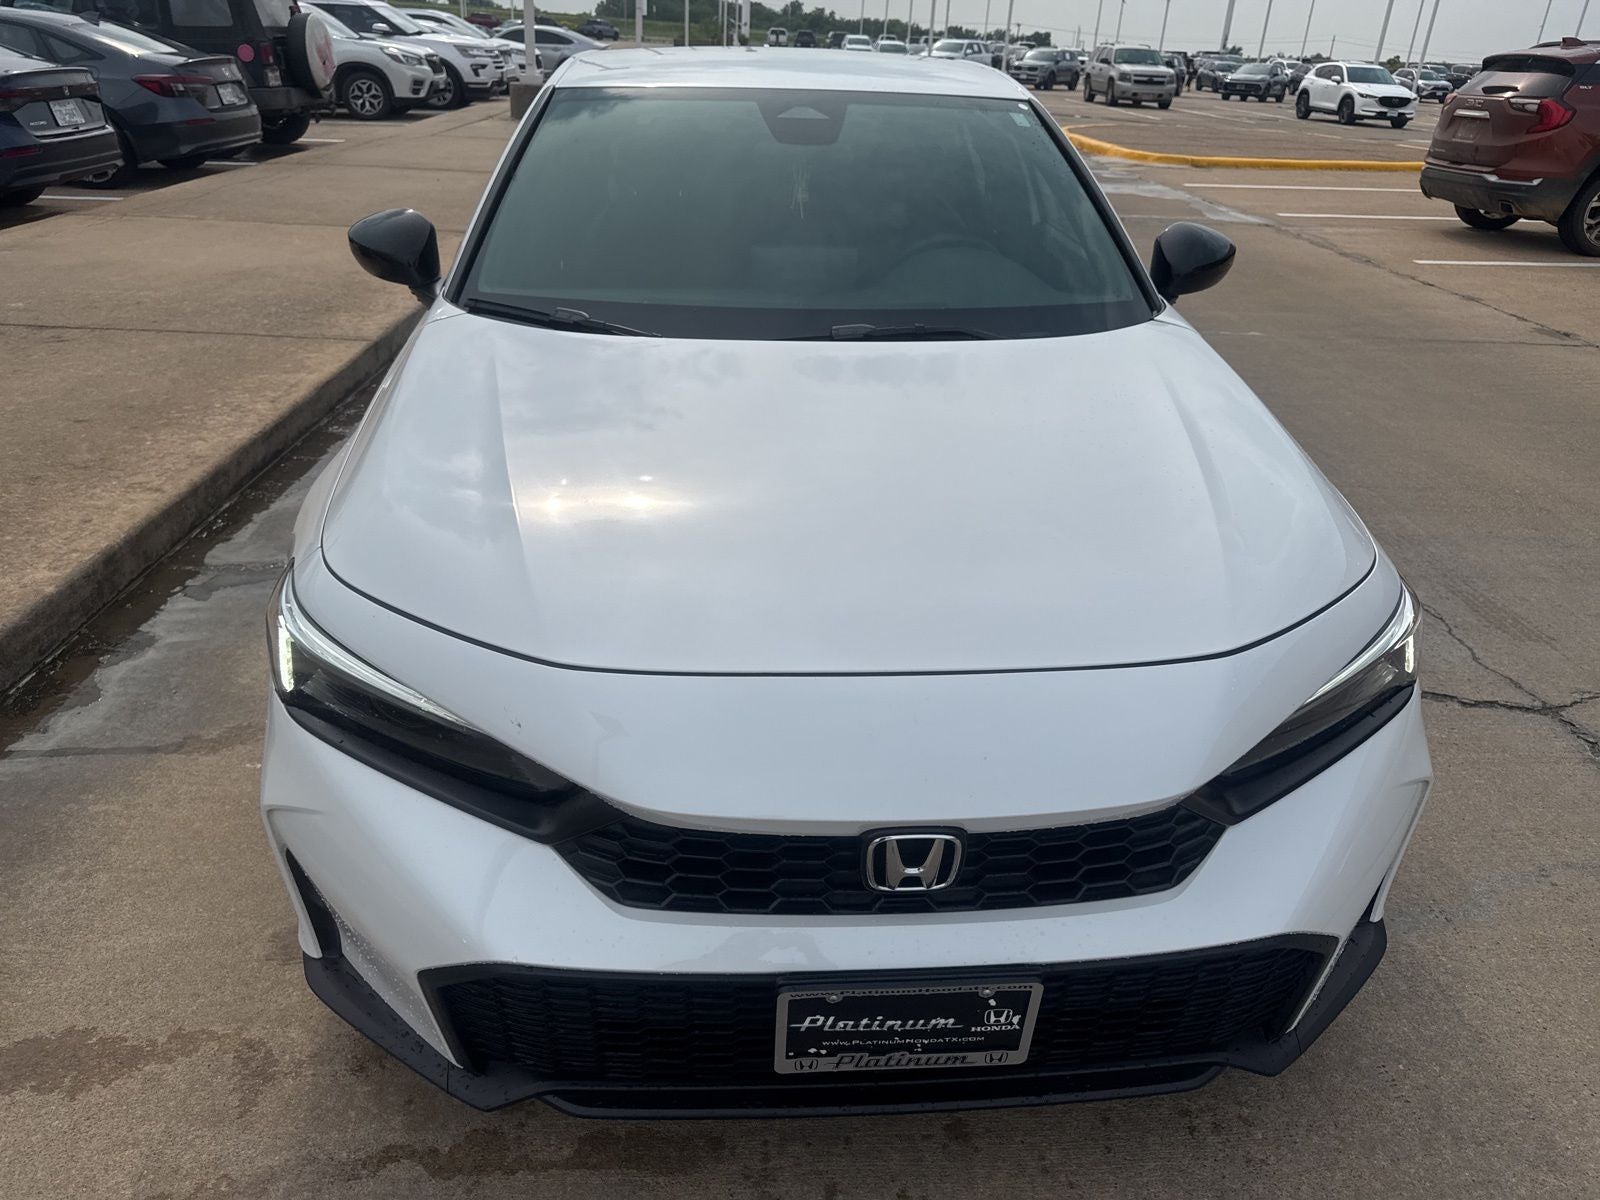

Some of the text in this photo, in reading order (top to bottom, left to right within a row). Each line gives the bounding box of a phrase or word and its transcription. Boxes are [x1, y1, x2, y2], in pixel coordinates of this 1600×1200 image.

[789, 1015, 964, 1032] Platinum
[970, 1024, 1021, 1032] HONDA
[826, 1053, 978, 1070] Platinum
